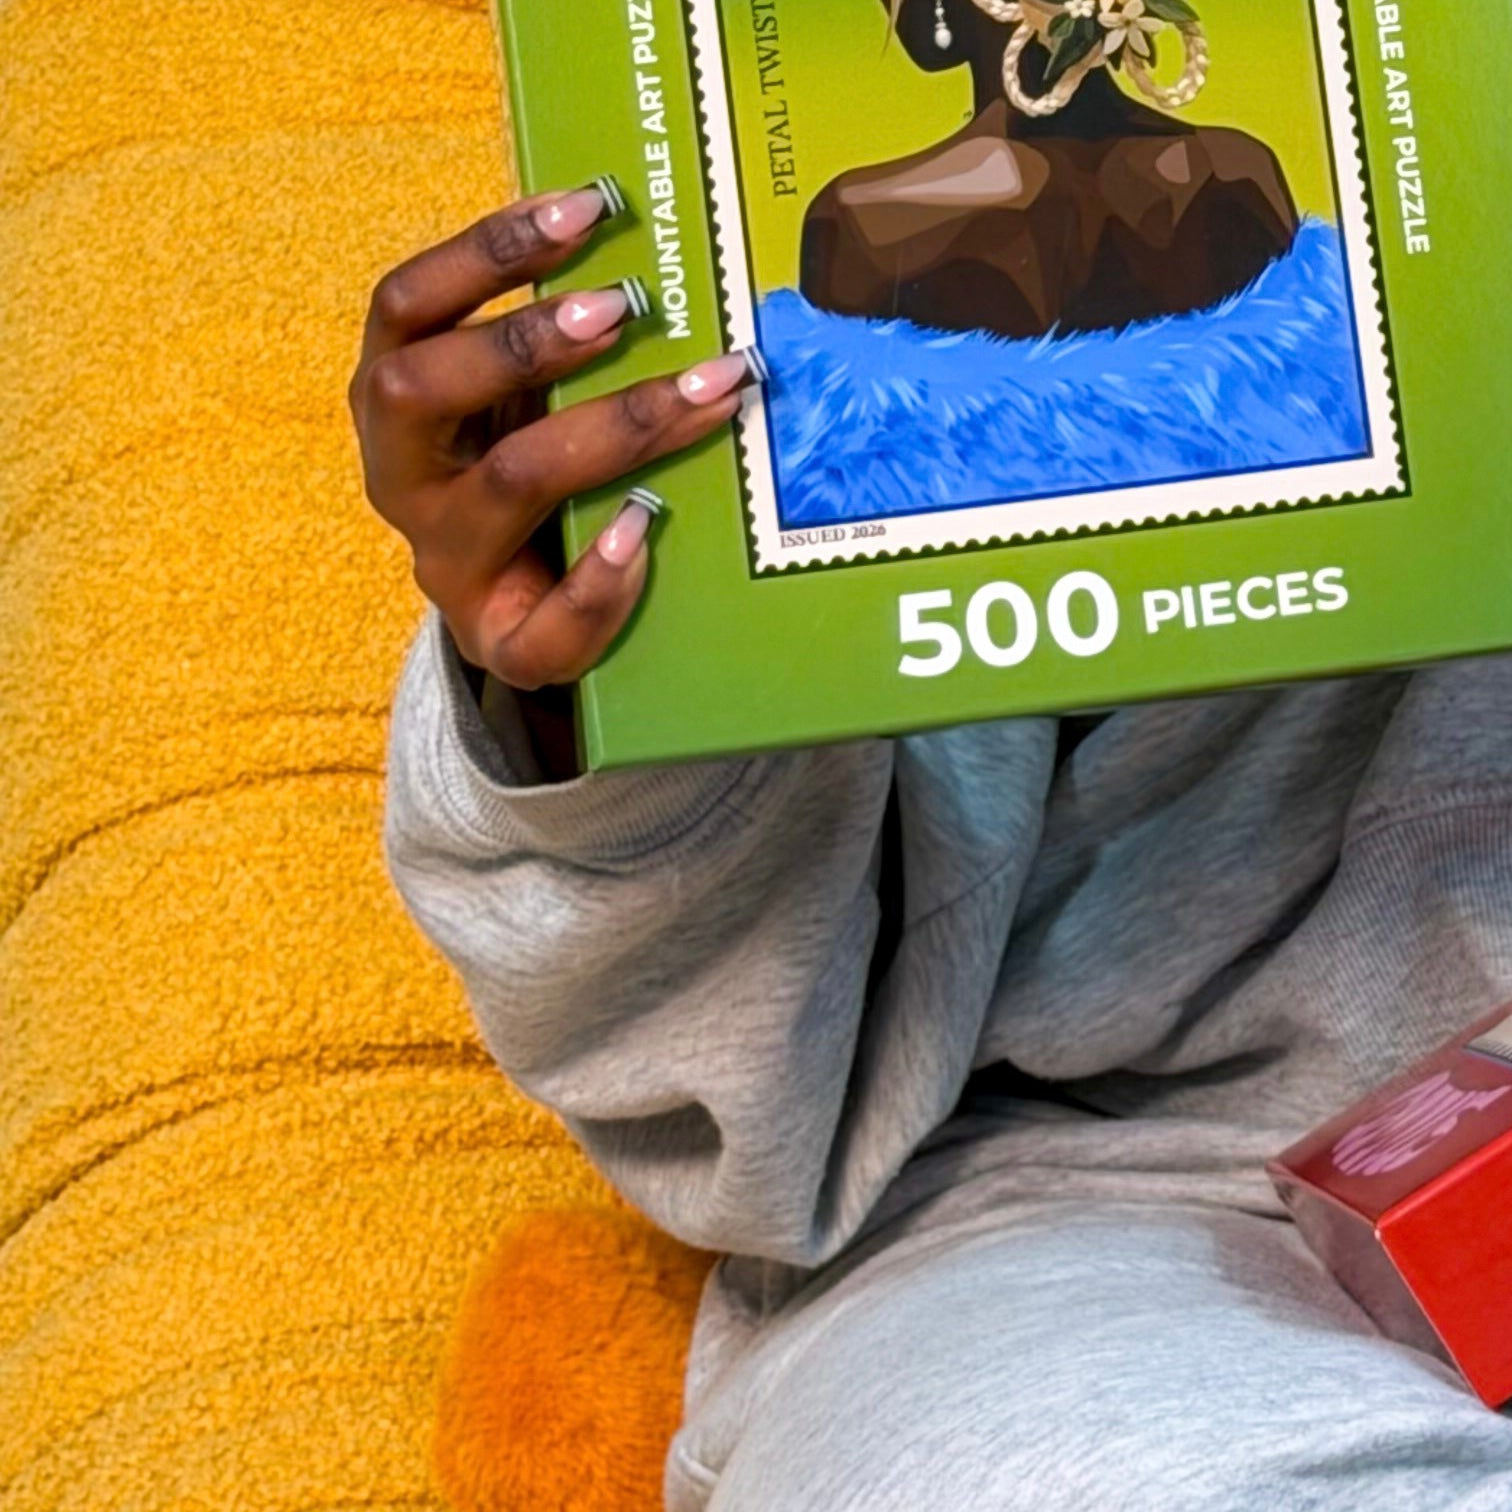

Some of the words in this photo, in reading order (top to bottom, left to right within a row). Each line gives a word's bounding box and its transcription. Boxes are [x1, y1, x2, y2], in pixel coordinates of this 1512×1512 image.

[635, 71, 667, 134] ART
[1383, 67, 1414, 130] ART
[764, 99, 798, 198] PETAL
[1392, 135, 1431, 255] PUZZLE
[645, 140, 691, 340] MOUNTABLE
[779, 527, 846, 549] ISSUED
[851, 523, 887, 540] 2026
[897, 571, 1120, 677] 500
[1142, 567, 1349, 634] PIECES
